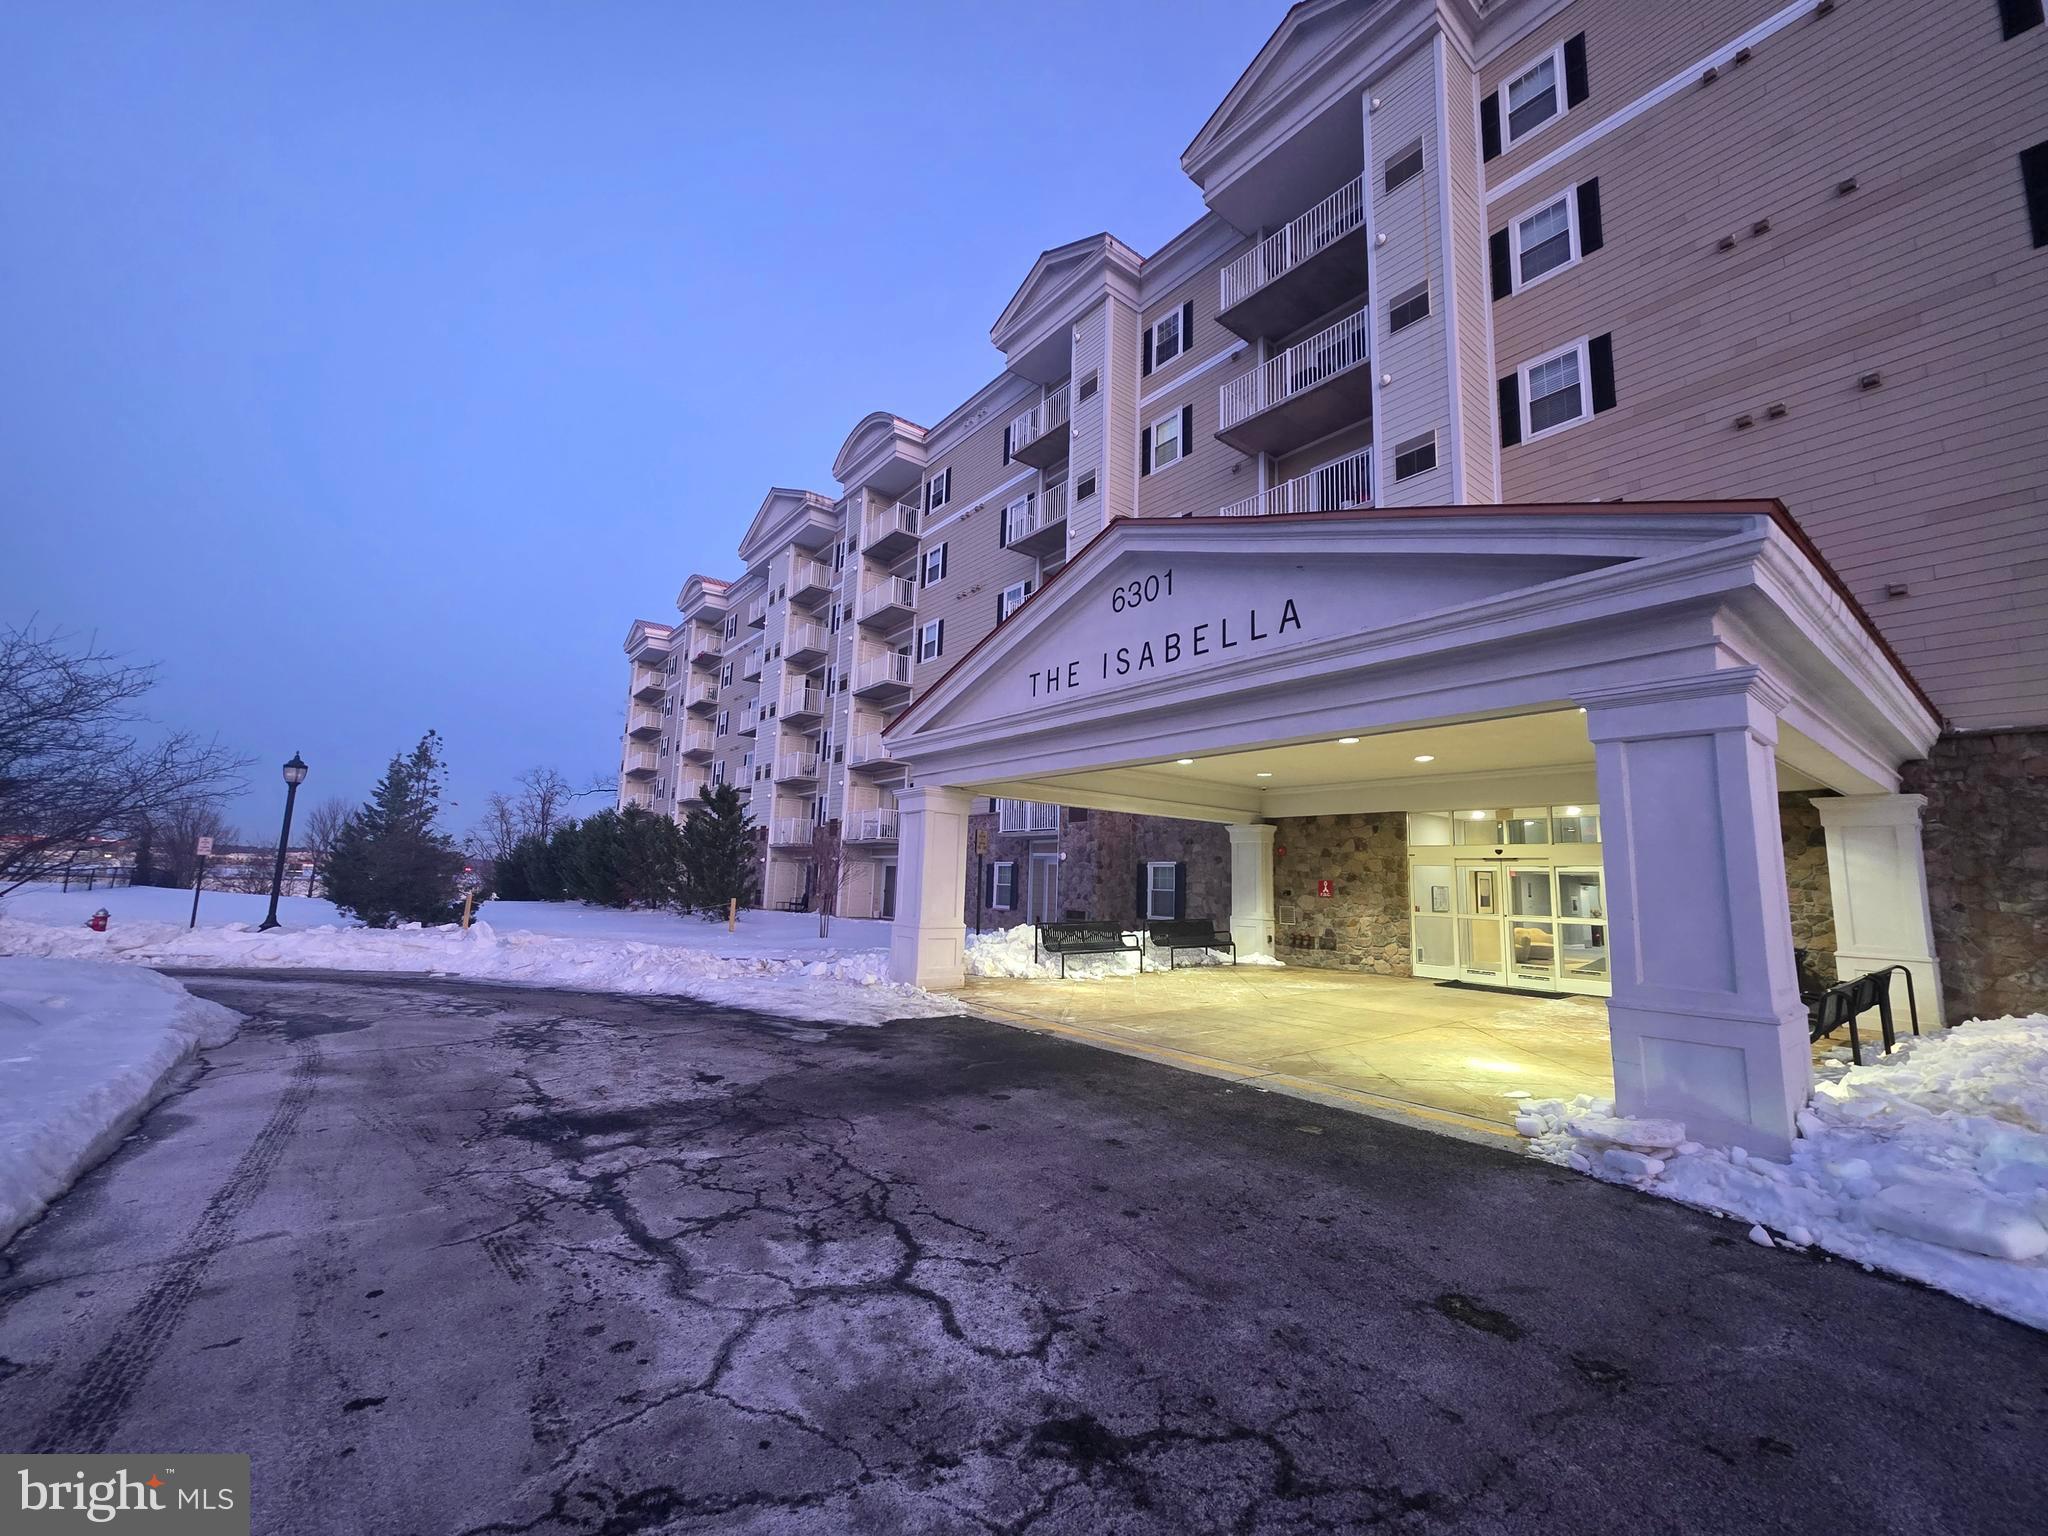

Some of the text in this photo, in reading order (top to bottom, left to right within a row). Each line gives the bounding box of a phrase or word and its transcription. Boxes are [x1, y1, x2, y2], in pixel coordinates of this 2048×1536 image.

[1112, 568, 1173, 613] 6301
[1029, 598, 1302, 697] THE ISABELLA
